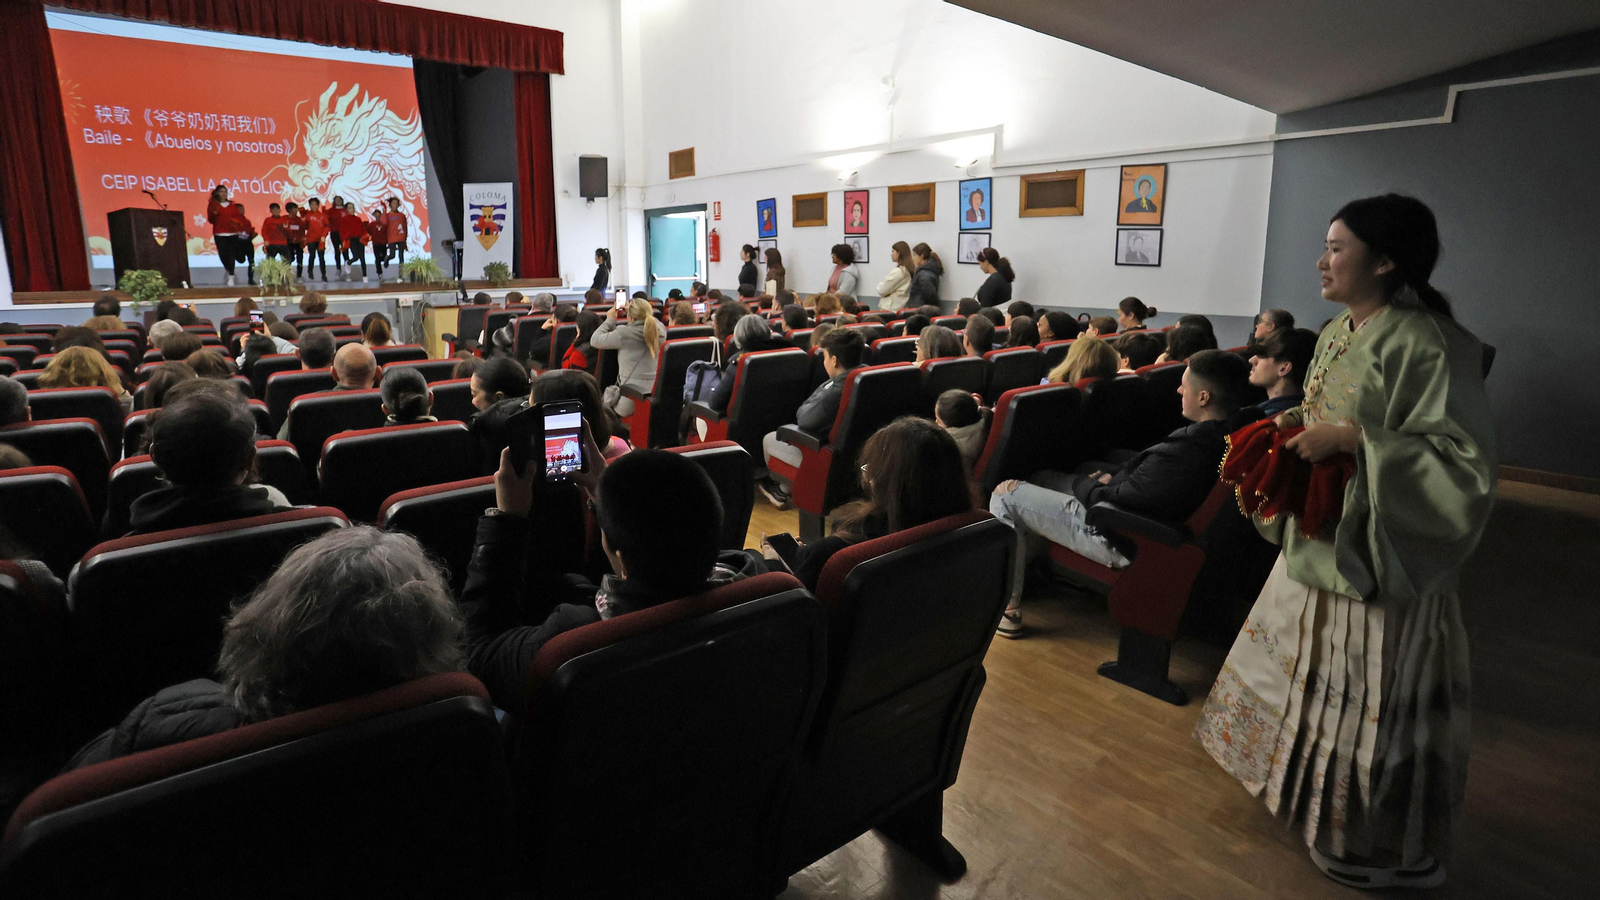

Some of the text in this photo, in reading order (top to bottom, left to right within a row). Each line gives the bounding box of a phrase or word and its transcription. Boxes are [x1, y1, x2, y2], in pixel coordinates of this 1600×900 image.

[94, 104, 277, 135] 秧歌 《爷爷奶奶和我们》
[82, 128, 122, 146] Baile
[215, 140, 224, 154] y
[101, 174, 139, 190] CEIP
[141, 176, 195, 192] ISABEL
[197, 178, 217, 193] LA
[469, 191, 507, 202] COLOMA
